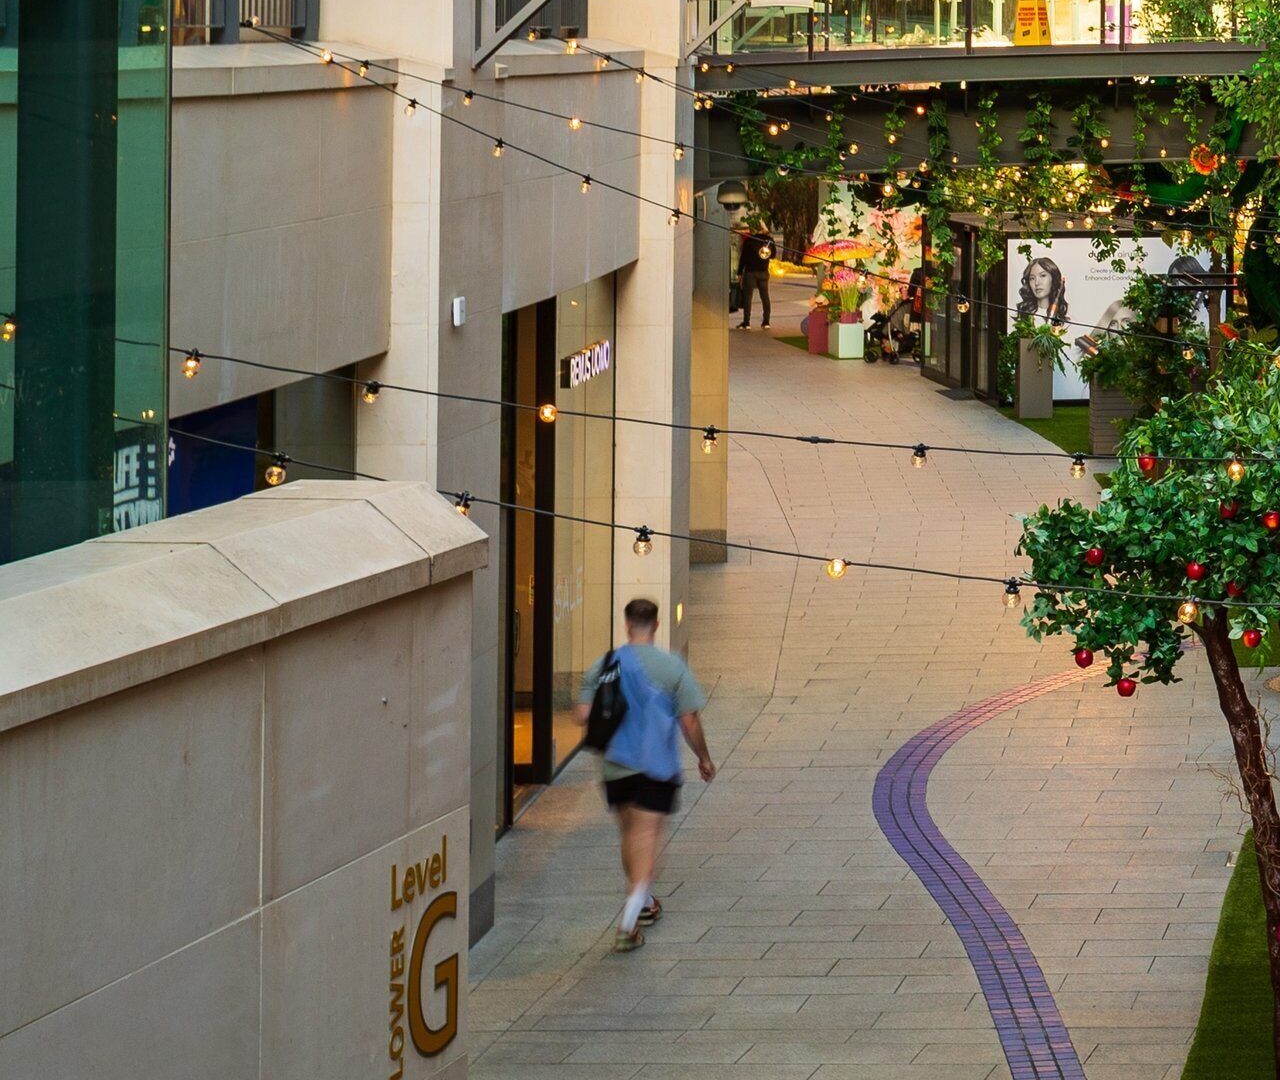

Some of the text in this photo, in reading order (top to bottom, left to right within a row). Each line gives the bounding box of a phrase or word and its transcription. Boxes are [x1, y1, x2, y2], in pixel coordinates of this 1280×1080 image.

[391, 834, 448, 912] Level
[389, 923, 407, 1080] LOWER
[406, 890, 459, 1058] G
